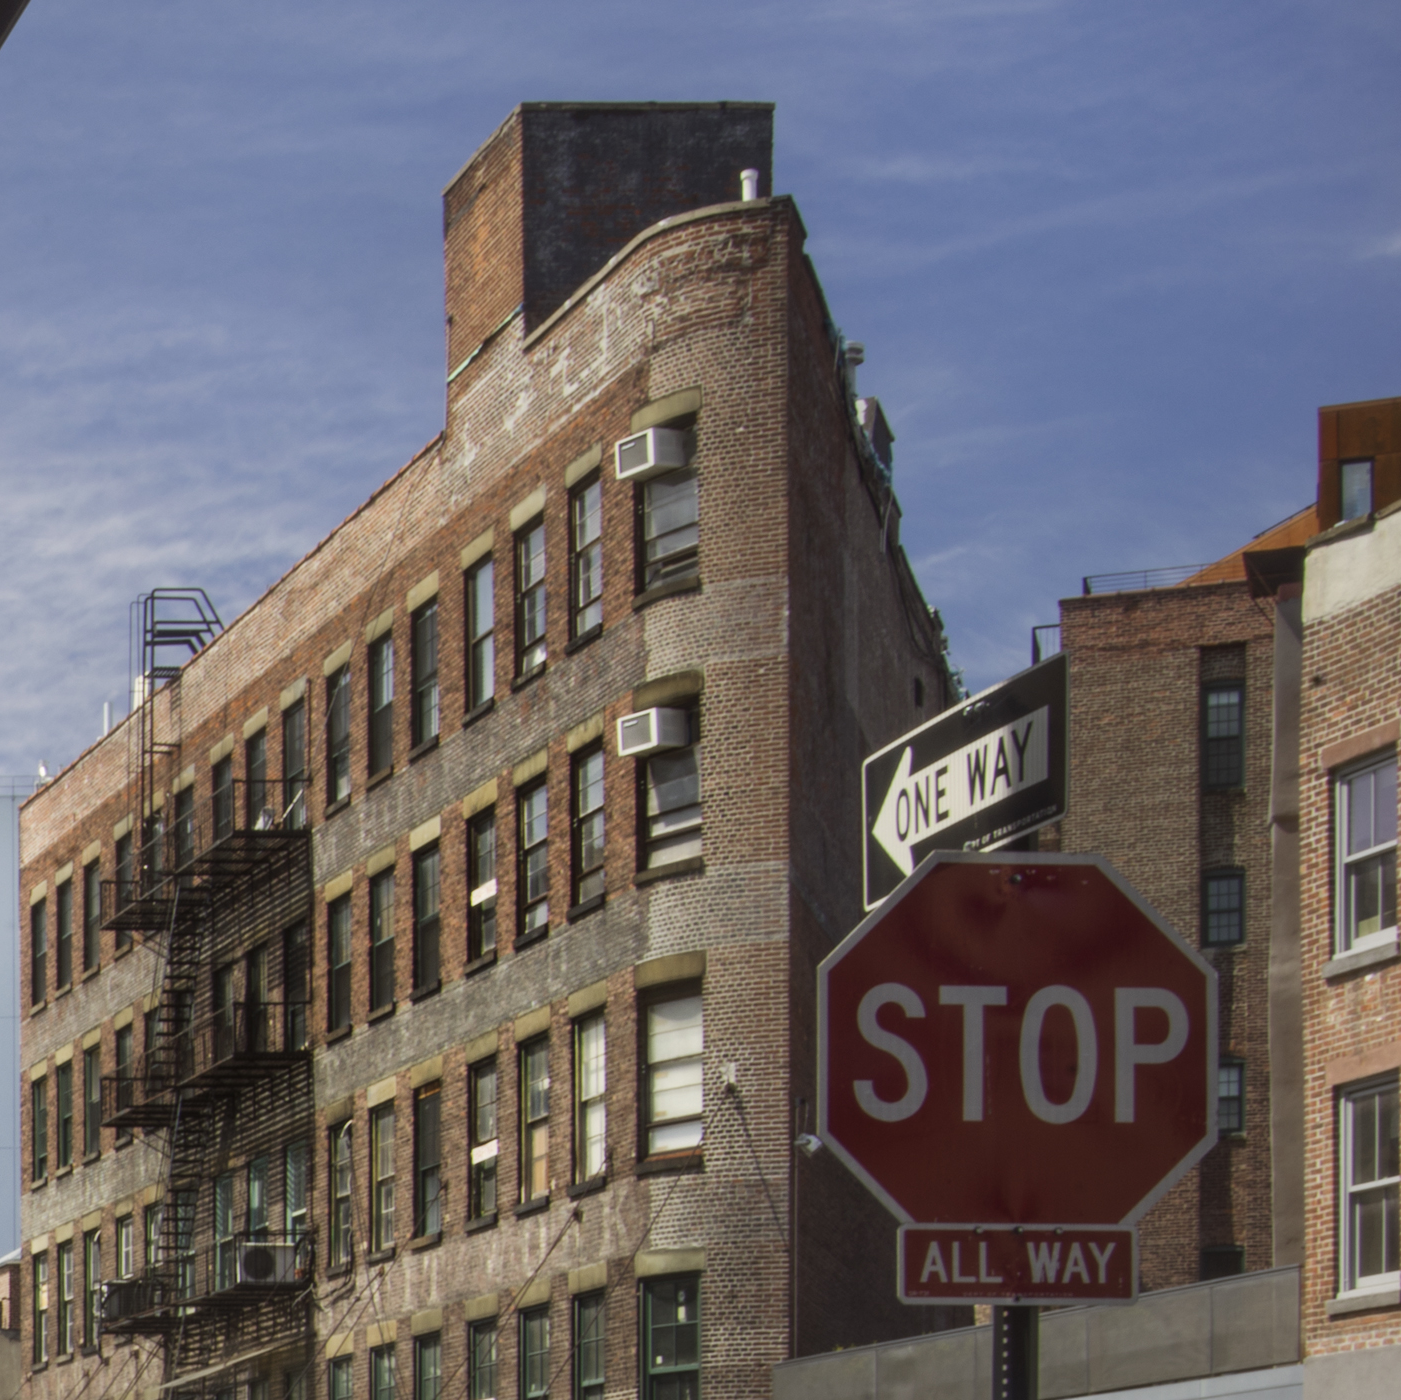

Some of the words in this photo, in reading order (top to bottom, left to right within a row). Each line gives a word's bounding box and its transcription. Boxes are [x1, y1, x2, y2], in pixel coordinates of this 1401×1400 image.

[896, 764, 950, 842] ONE
[967, 720, 1034, 807] WAY
[993, 803, 1058, 840] TRANSPORTATION
[853, 982, 1190, 1125] STOP
[920, 1241, 1003, 1283] ALL
[1026, 1241, 1117, 1284] WAY
